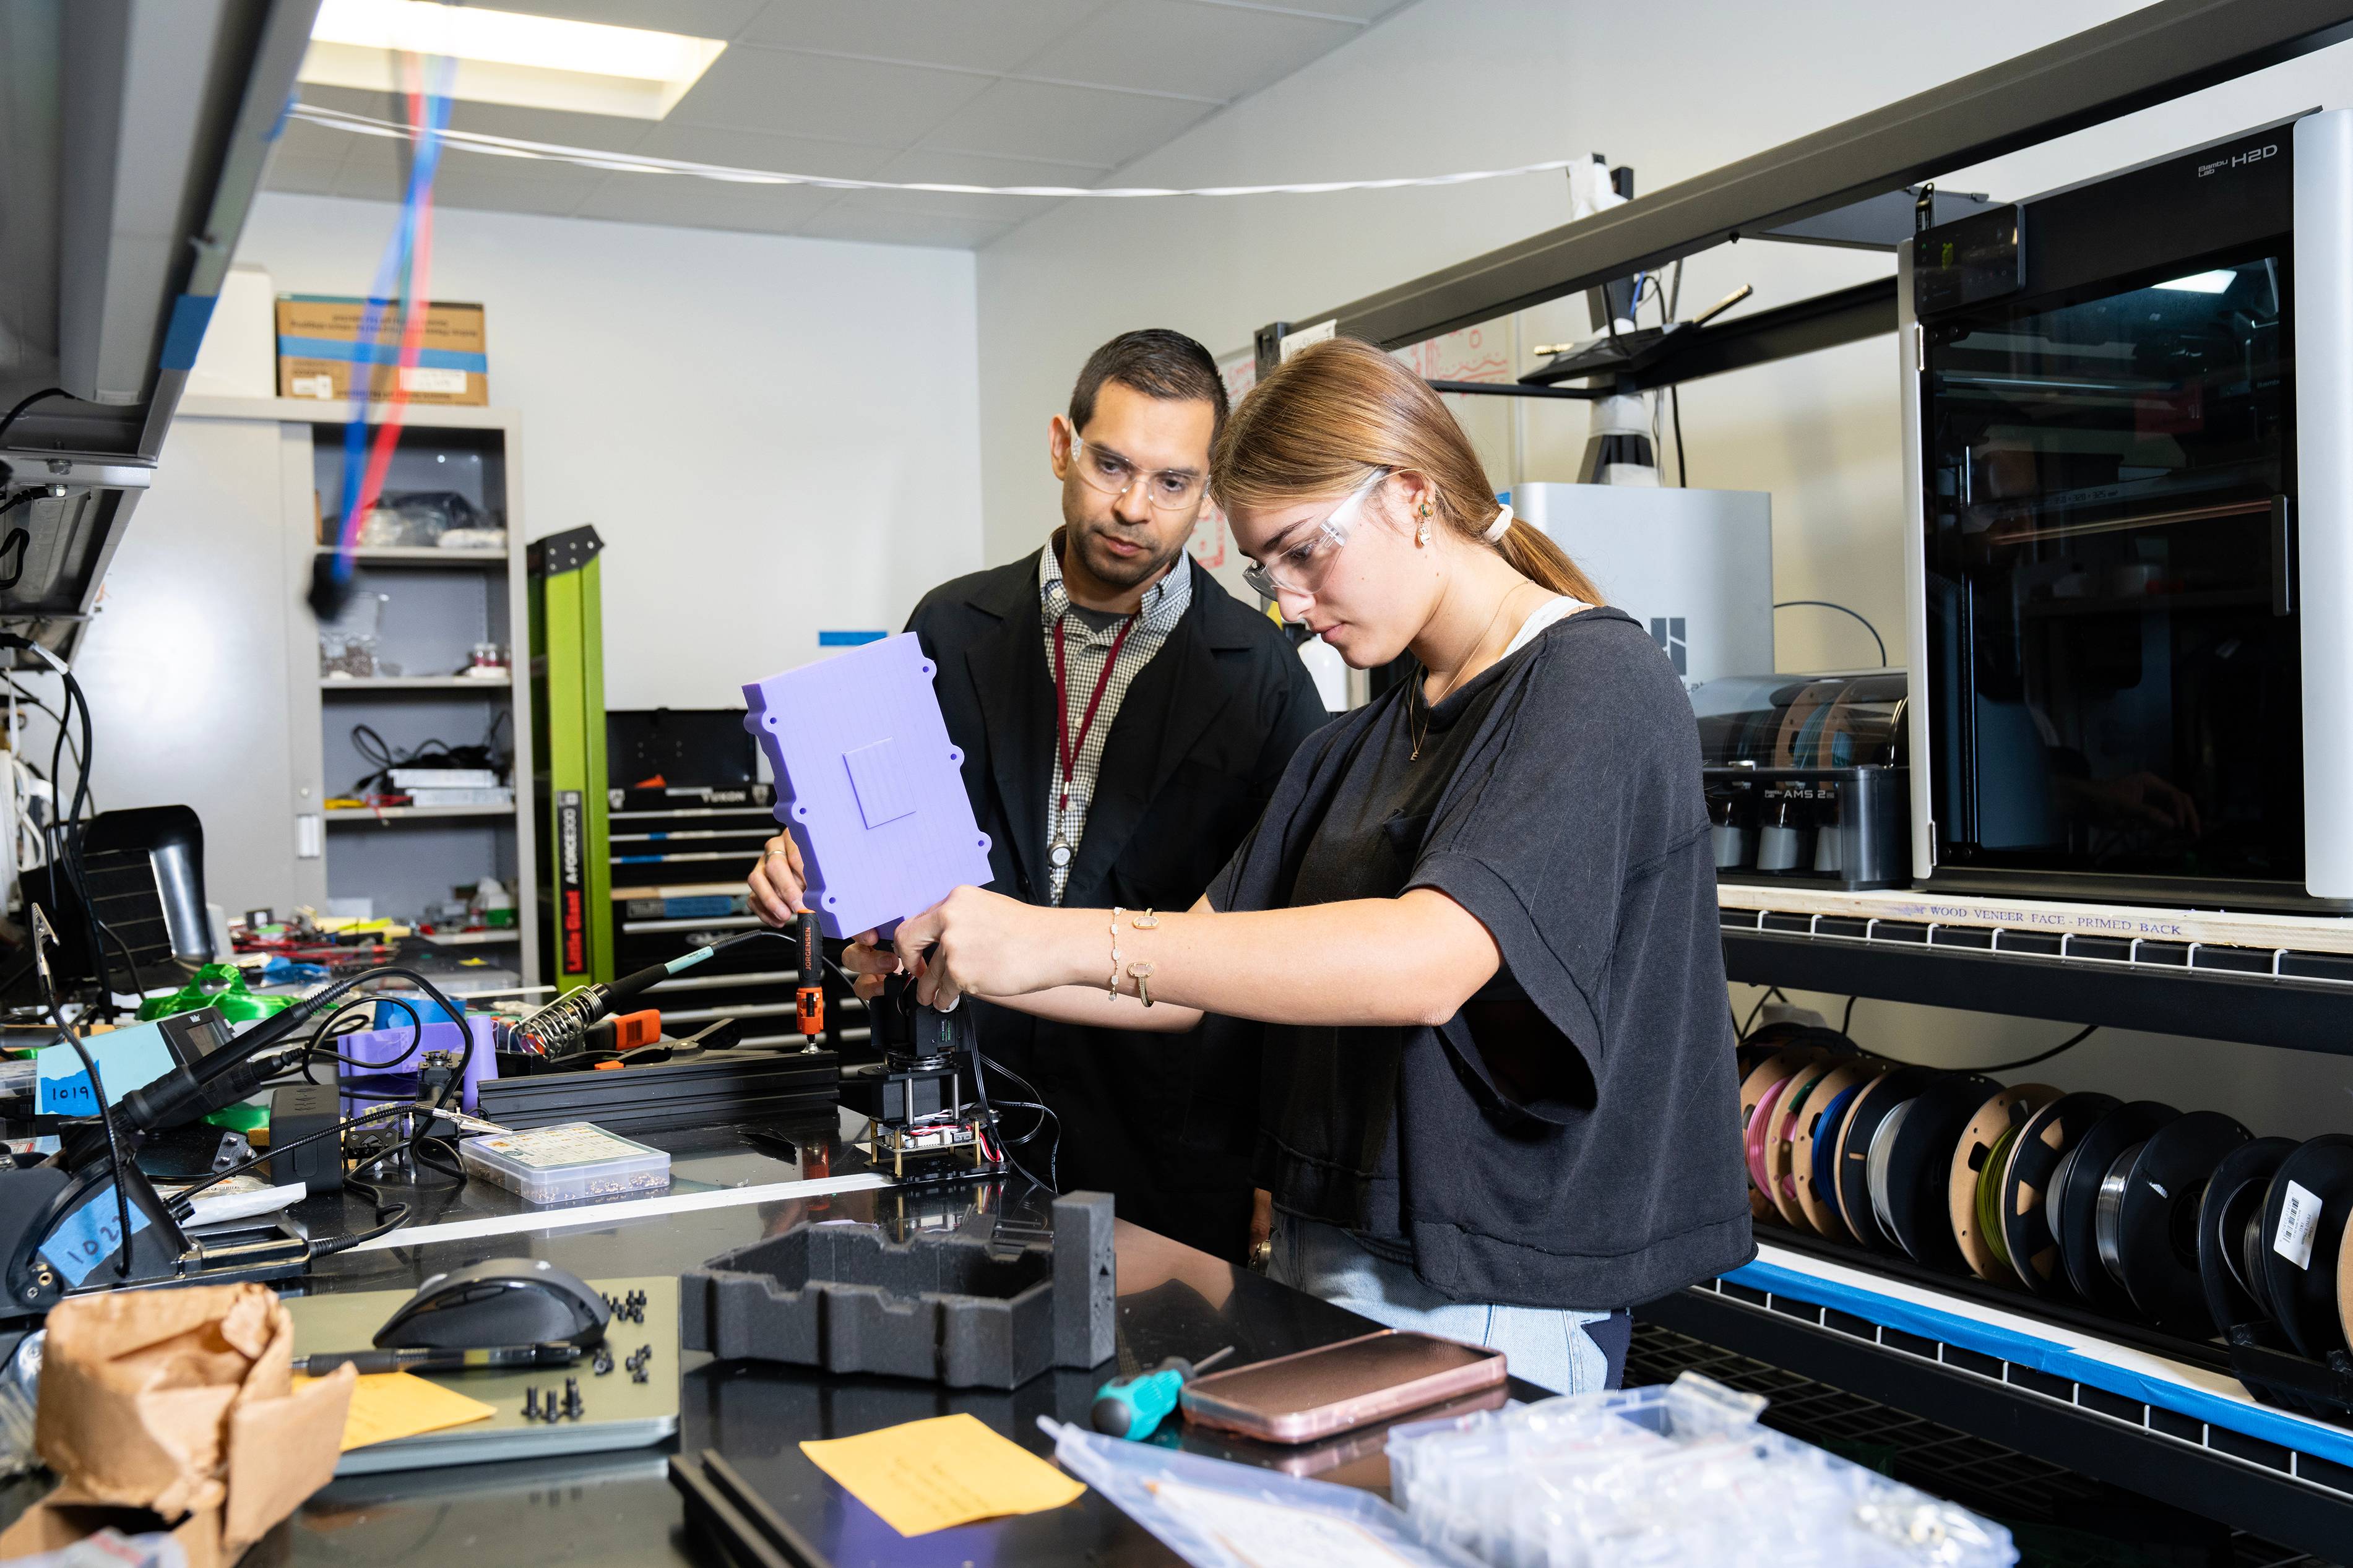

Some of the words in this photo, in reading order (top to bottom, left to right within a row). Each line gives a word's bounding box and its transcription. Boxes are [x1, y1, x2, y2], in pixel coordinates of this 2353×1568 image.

[2232, 144, 2277, 168] H2D
[2198, 159, 2228, 173] Bambu
[2198, 168, 2214, 178] Lab
[1784, 790, 1813, 799] AMS
[1818, 790, 1826, 799] 2
[1930, 906, 1967, 917] WOOD
[1974, 909, 2024, 921] VENEER
[2032, 913, 2065, 925] FACE
[2077, 917, 2131, 930] PRIMED
[2140, 923, 2182, 935] BACK
[53, 1086, 89, 1100] 1019
